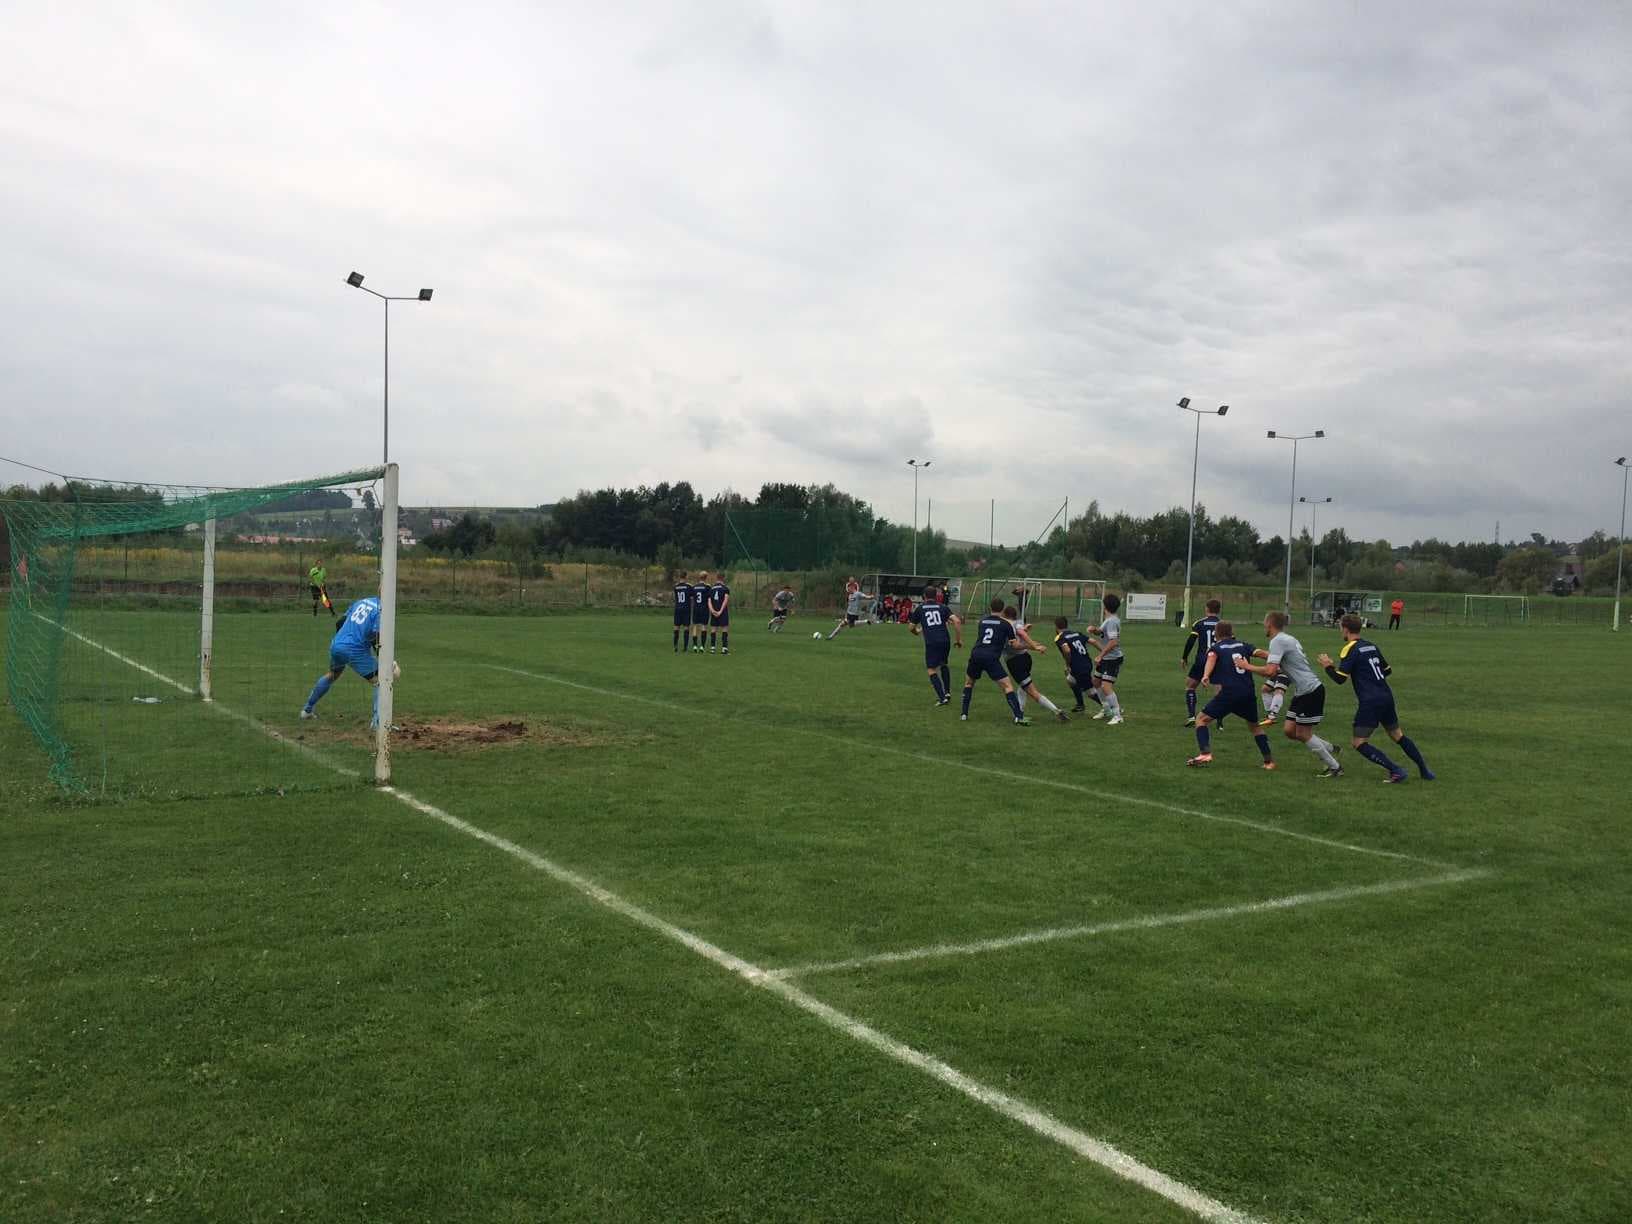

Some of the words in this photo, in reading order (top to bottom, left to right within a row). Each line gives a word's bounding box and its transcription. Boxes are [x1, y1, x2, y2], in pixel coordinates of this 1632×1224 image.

[677, 591, 686, 603] 10
[696, 592, 702, 604] 3
[925, 610, 942, 627] 20
[982, 628, 994, 644] 2
